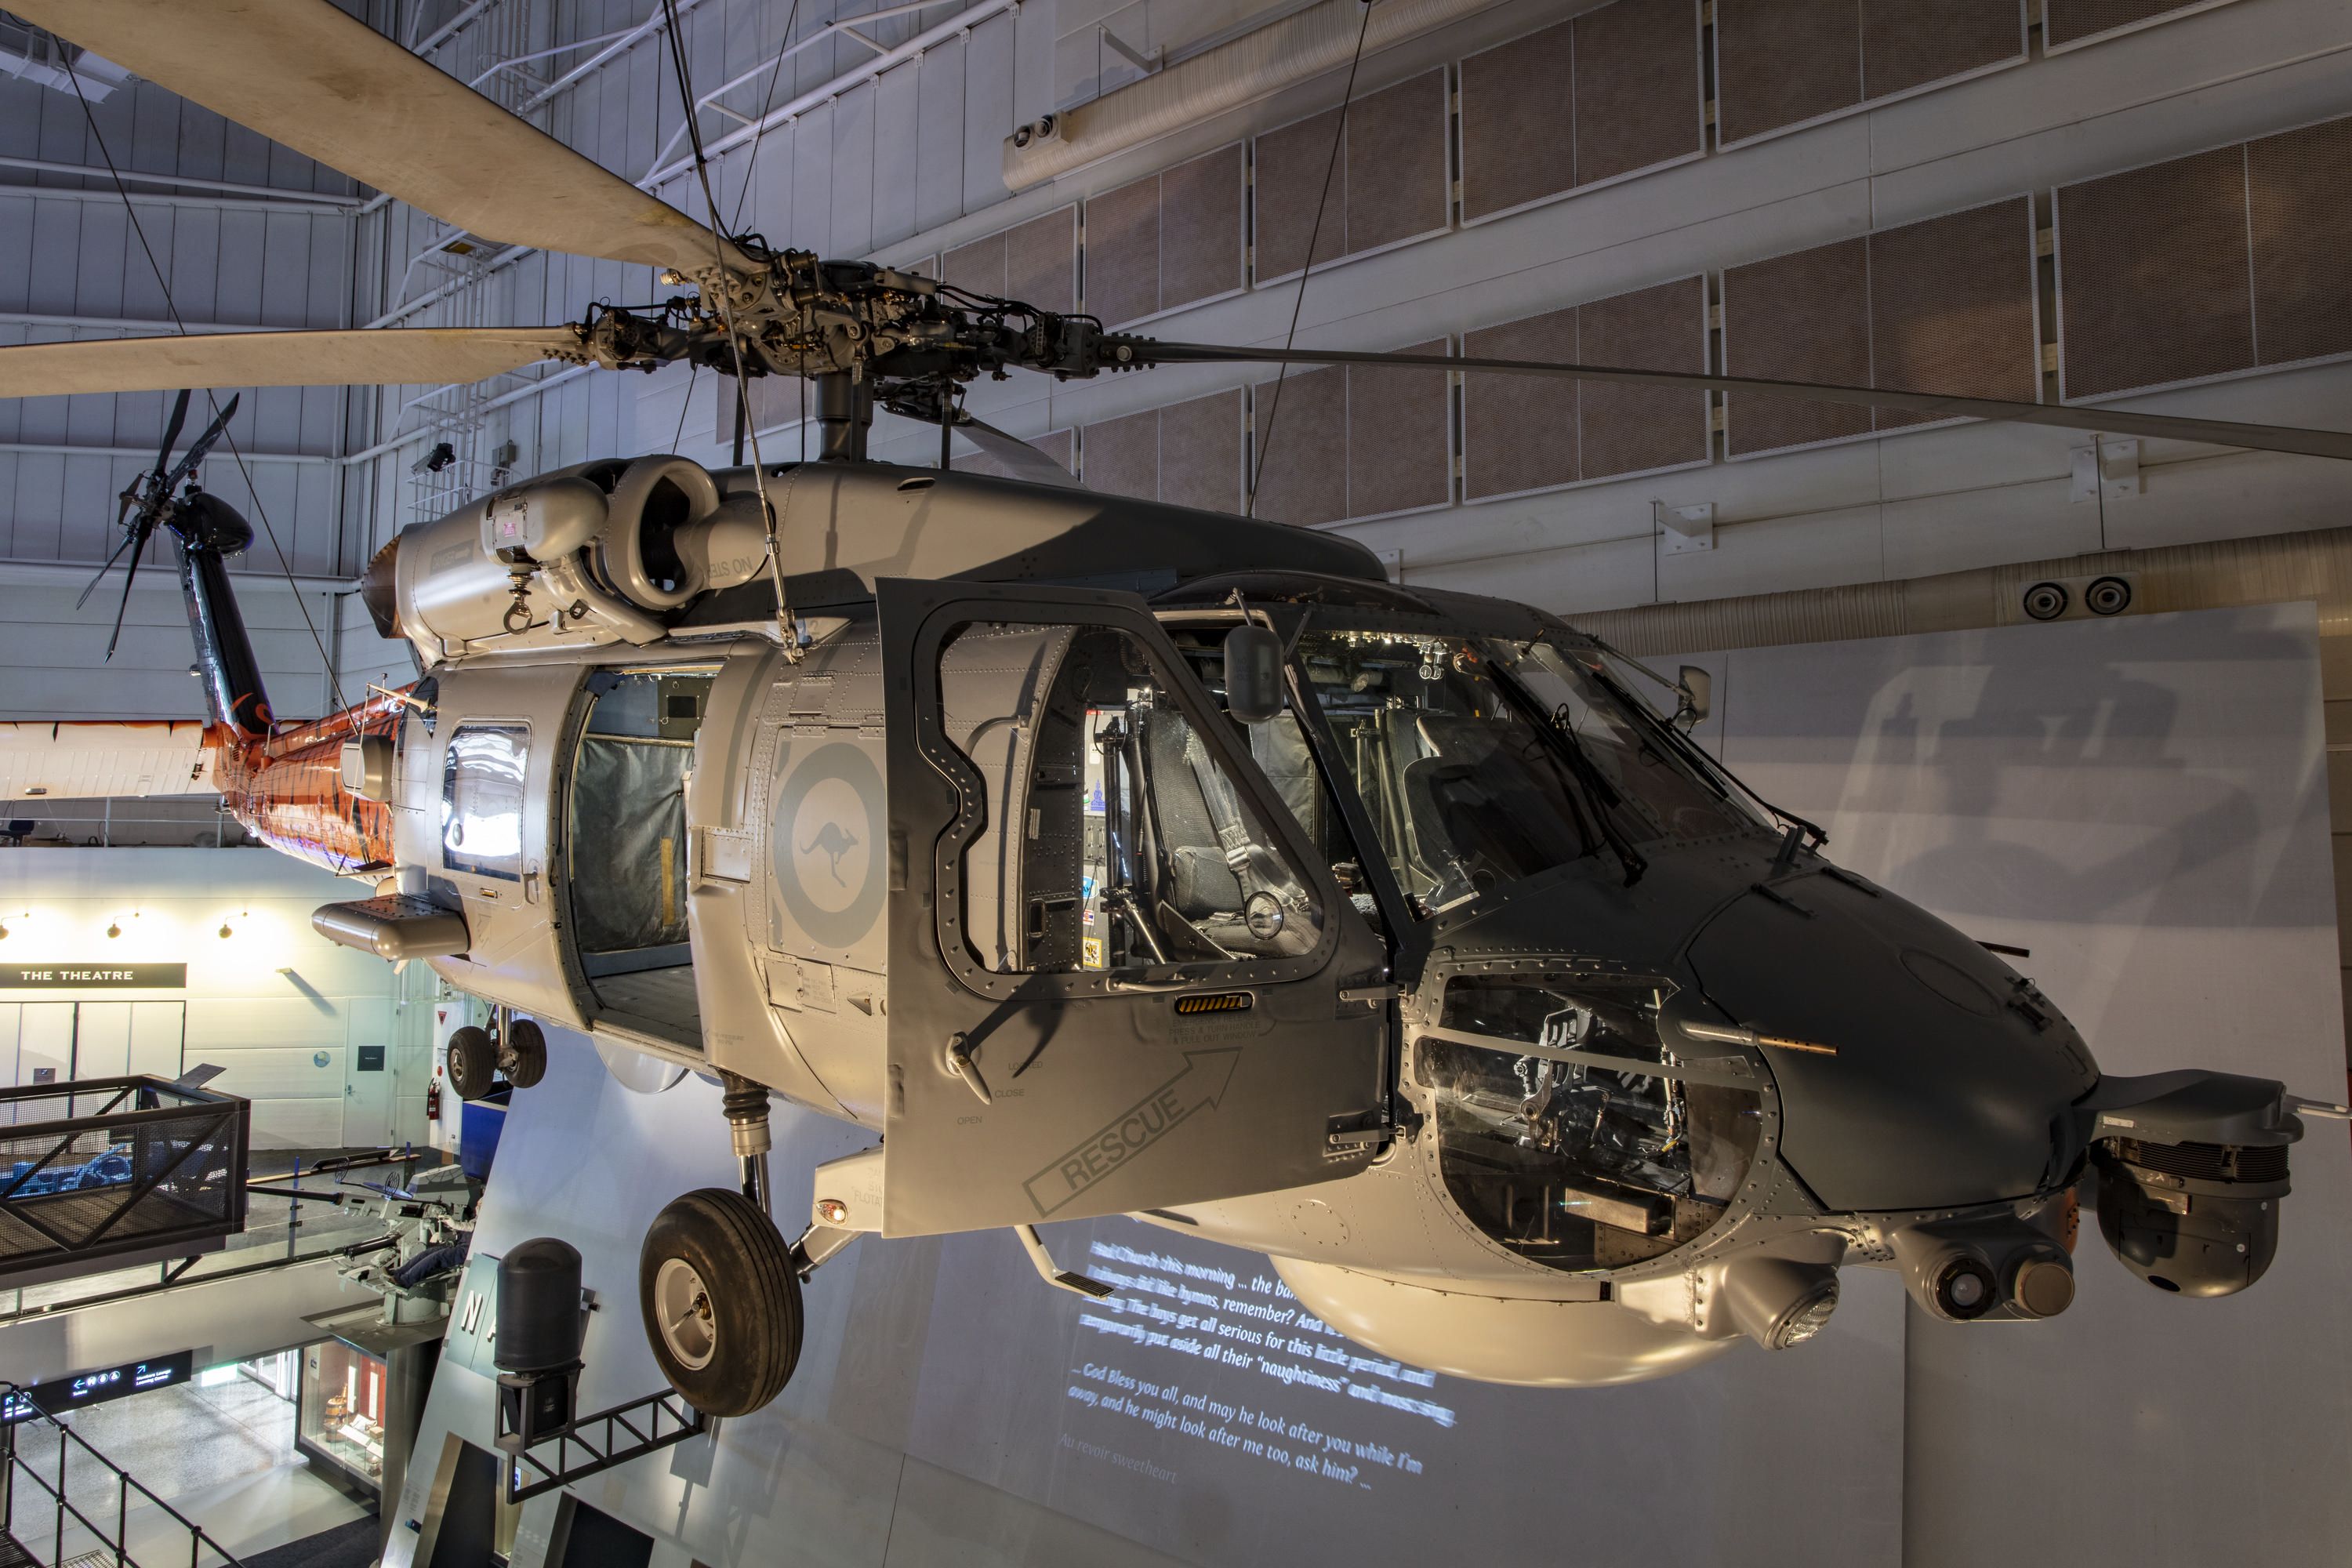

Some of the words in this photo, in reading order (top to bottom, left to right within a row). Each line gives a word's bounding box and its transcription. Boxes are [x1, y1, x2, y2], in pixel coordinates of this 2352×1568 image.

[708, 561, 730, 578] STE
[732, 557, 753, 574] NO
[21, 971, 53, 981] THE
[60, 971, 133, 981] THEATRE
[1168, 1027, 1196, 1036] PRESS
[1207, 1024, 1228, 1033] TURN
[1229, 1021, 1261, 1031] HANDLE
[1203, 1033, 1220, 1042] OUT
[994, 1088, 1025, 1098] CLOSE
[956, 1116, 983, 1126] OPEN
[1060, 1089, 1185, 1191] RESCUE
[1185, 1263, 1236, 1290] morning
[1251, 1275, 1272, 1294] the
[1275, 1279, 1298, 1301] ba
[1223, 1298, 1295, 1325] remember?
[1175, 1314, 1200, 1329] get
[1200, 1316, 1218, 1333] all
[1218, 1323, 1262, 1345] serious
[1265, 1331, 1285, 1351] for
[1287, 1338, 1313, 1357] this
[1203, 1344, 1221, 1360] all
[1222, 1348, 1254, 1369] their
[1107, 1369, 1137, 1390] Bless
[1135, 1380, 1159, 1397] you
[1161, 1385, 1178, 1405] all,
[1182, 1394, 1207, 1411] and
[1208, 1399, 1236, 1423] may
[1239, 1406, 1254, 1425] he
[1258, 1410, 1286, 1436] look
[1288, 1422, 1323, 1445] after
[1322, 1434, 1352, 1454] you
[1355, 1442, 1395, 1467] while
[1068, 1385, 1099, 1408] away,
[1101, 1396, 1124, 1412] and
[1125, 1399, 1140, 1417] he
[1142, 1408, 1178, 1430] might
[1179, 1415, 1207, 1439] look
[1208, 1426, 1241, 1449] after
[1243, 1438, 1264, 1457] me
[1266, 1444, 1292, 1468] too,
[1295, 1454, 1319, 1475] ask
[1321, 1457, 1359, 1484] him?
[1058, 1432, 1075, 1448] Au
[1077, 1439, 1110, 1461] revoir
[1111, 1452, 1178, 1484] sweetheart
